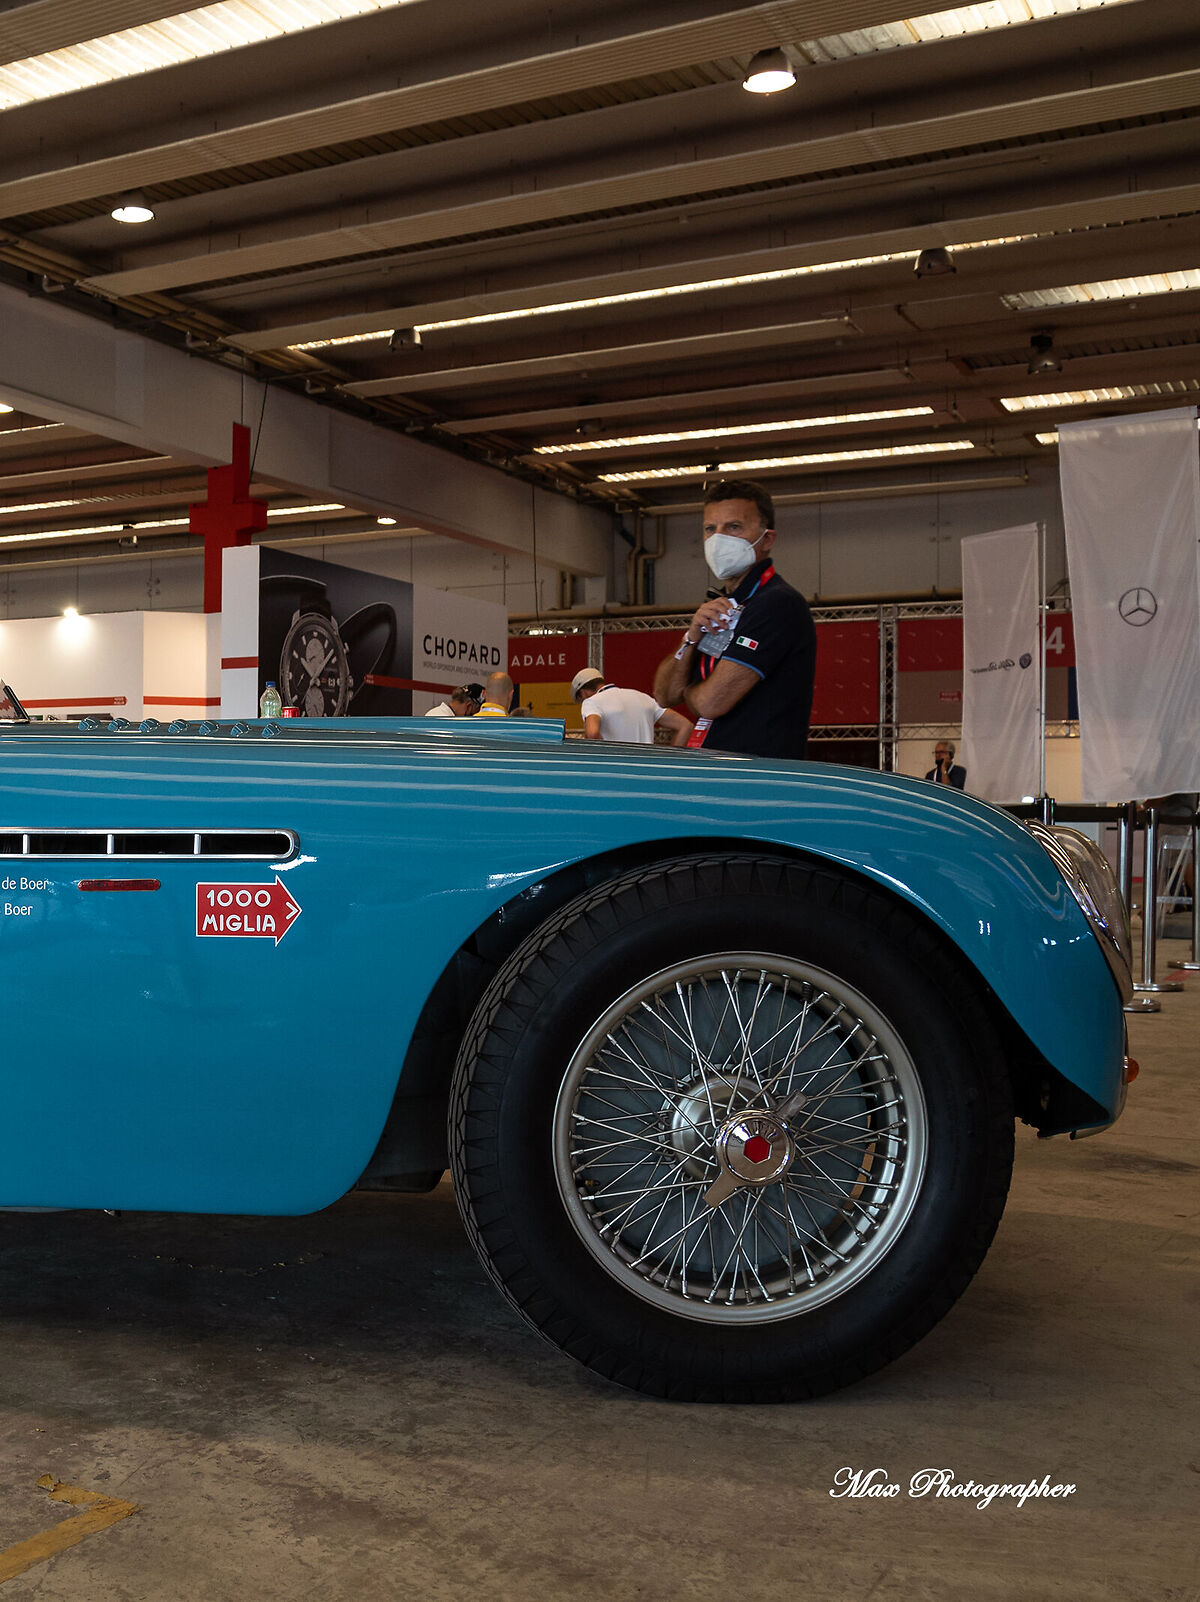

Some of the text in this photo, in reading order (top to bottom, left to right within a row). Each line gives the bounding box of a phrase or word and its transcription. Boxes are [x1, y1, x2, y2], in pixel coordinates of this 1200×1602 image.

[1045, 626, 1065, 654] 4
[423, 634, 501, 666] CHOPARD
[1, 876, 17, 890] de
[19, 877, 48, 890] Boer
[206, 889, 271, 907] 1000
[4, 902, 33, 916] Boer
[202, 914, 276, 932] MIGLIA
